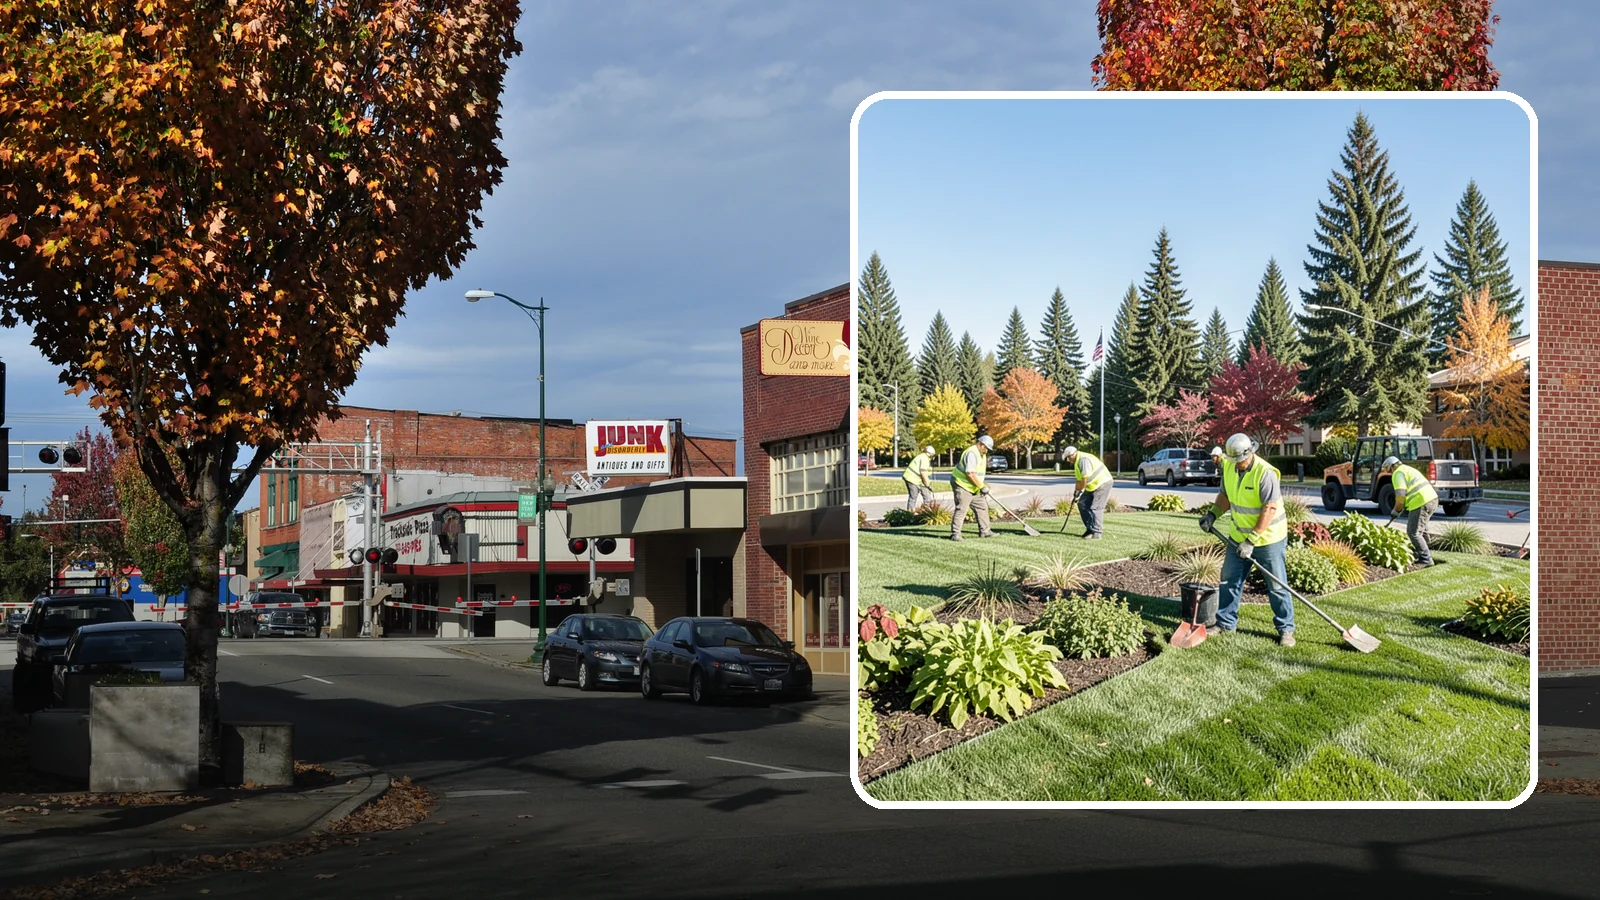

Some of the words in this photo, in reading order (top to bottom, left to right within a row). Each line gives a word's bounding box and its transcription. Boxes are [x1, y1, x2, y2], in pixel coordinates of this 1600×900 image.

[595, 425, 665, 457] JUNK
[607, 446, 646, 454] DISORDERLY
[597, 461, 628, 470] ANTIQUES
[631, 461, 643, 470] AND
[647, 461, 665, 470] GIFTS
[390, 521, 413, 539] Trackside
[414, 519, 429, 535] Pizza
